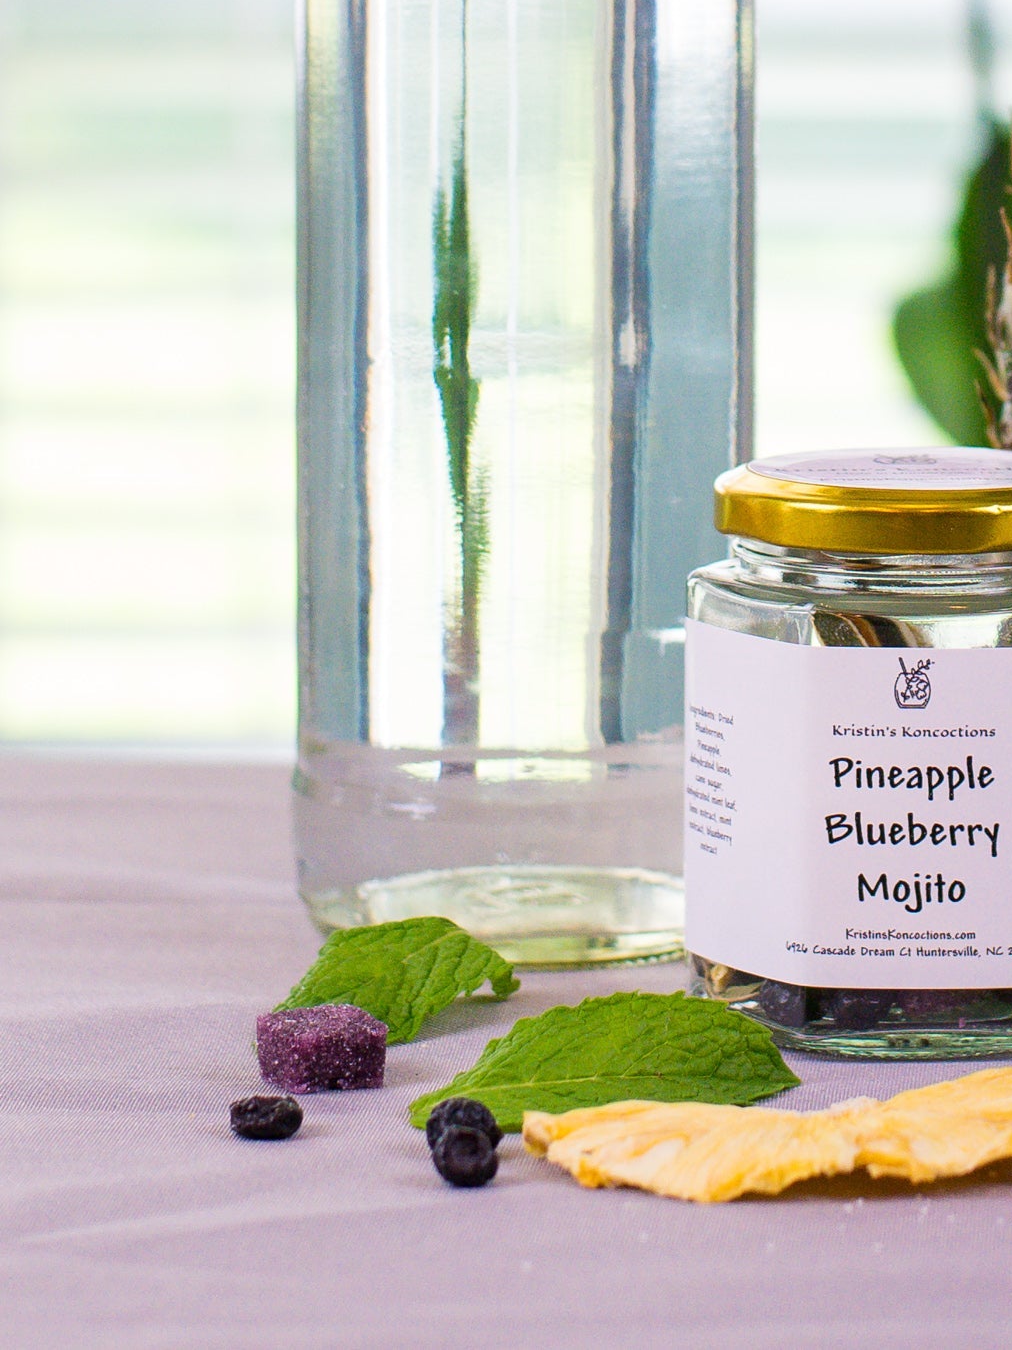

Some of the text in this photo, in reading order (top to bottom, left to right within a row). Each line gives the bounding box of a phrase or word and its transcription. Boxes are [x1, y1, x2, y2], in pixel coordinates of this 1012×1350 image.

[833, 724, 995, 737] Kristin's Koncoctions
[829, 756, 995, 801] Pineapple
[825, 812, 1000, 857] Blueberry
[858, 873, 966, 913] Mojito
[846, 929, 976, 940] KristinsKoncoctions.com
[813, 945, 856, 955] Cascade
[861, 947, 895, 956] Dream
[900, 947, 911, 957] Ct
[917, 946, 981, 957] Huntersville,
[986, 946, 1003, 955] NC
